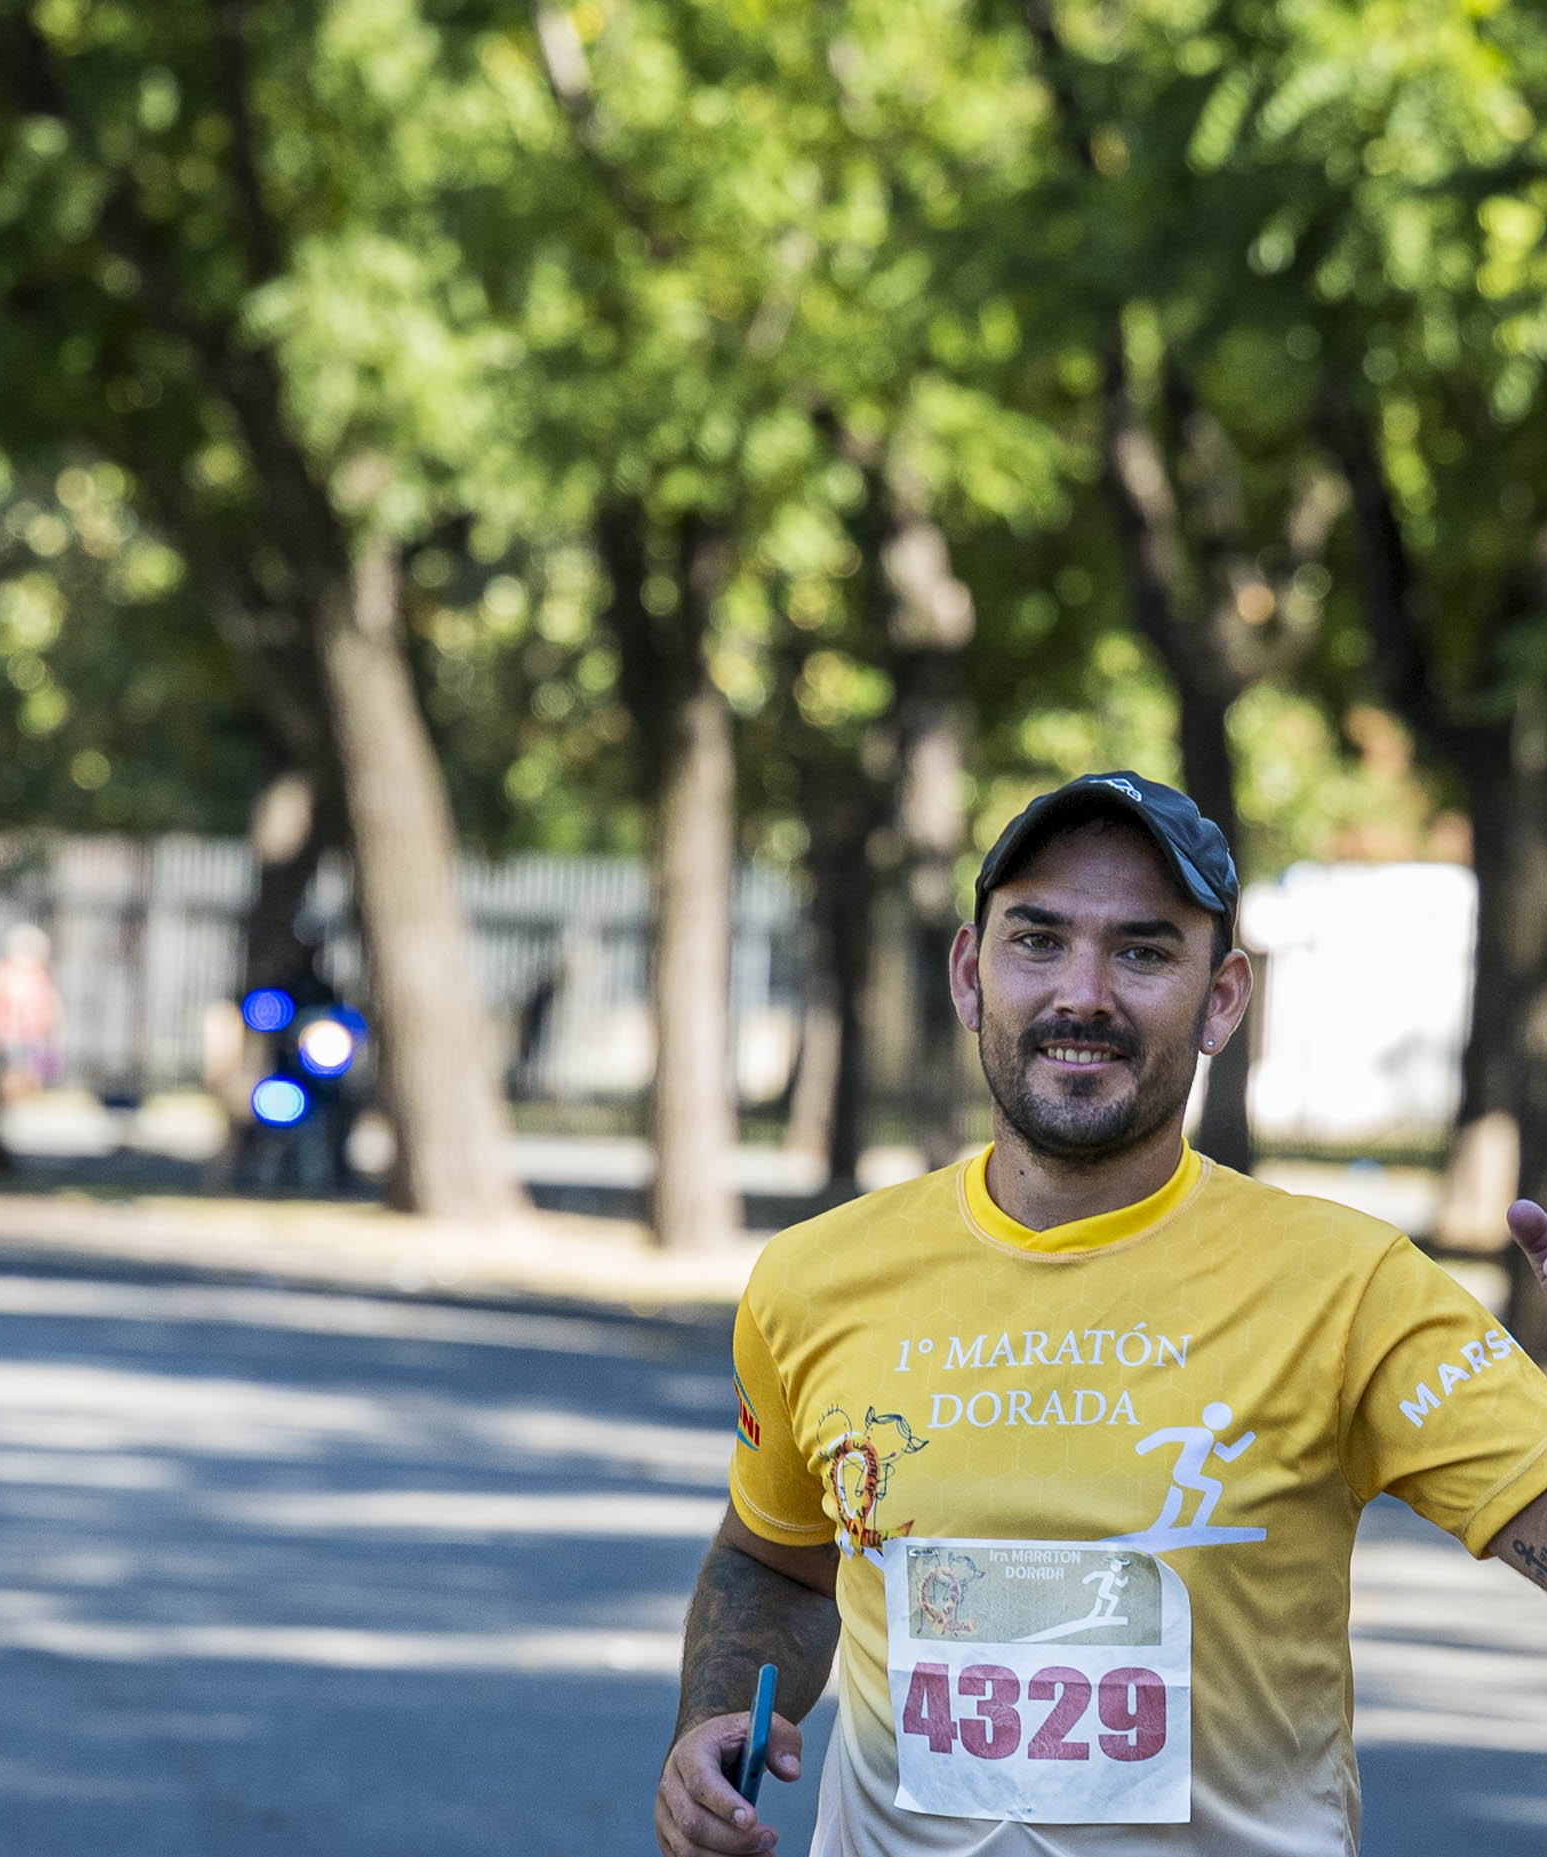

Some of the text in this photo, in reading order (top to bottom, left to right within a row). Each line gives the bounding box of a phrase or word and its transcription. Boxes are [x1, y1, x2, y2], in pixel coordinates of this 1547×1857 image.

[942, 1321, 1192, 1370] MARATÓN
[1398, 1329, 1524, 1428] MARS
[927, 1389, 1140, 1429] DORADA
[1005, 1566, 1065, 1581] DORADA
[1011, 1549, 1081, 1564] MARATON
[902, 1661, 1167, 1762] 4329
